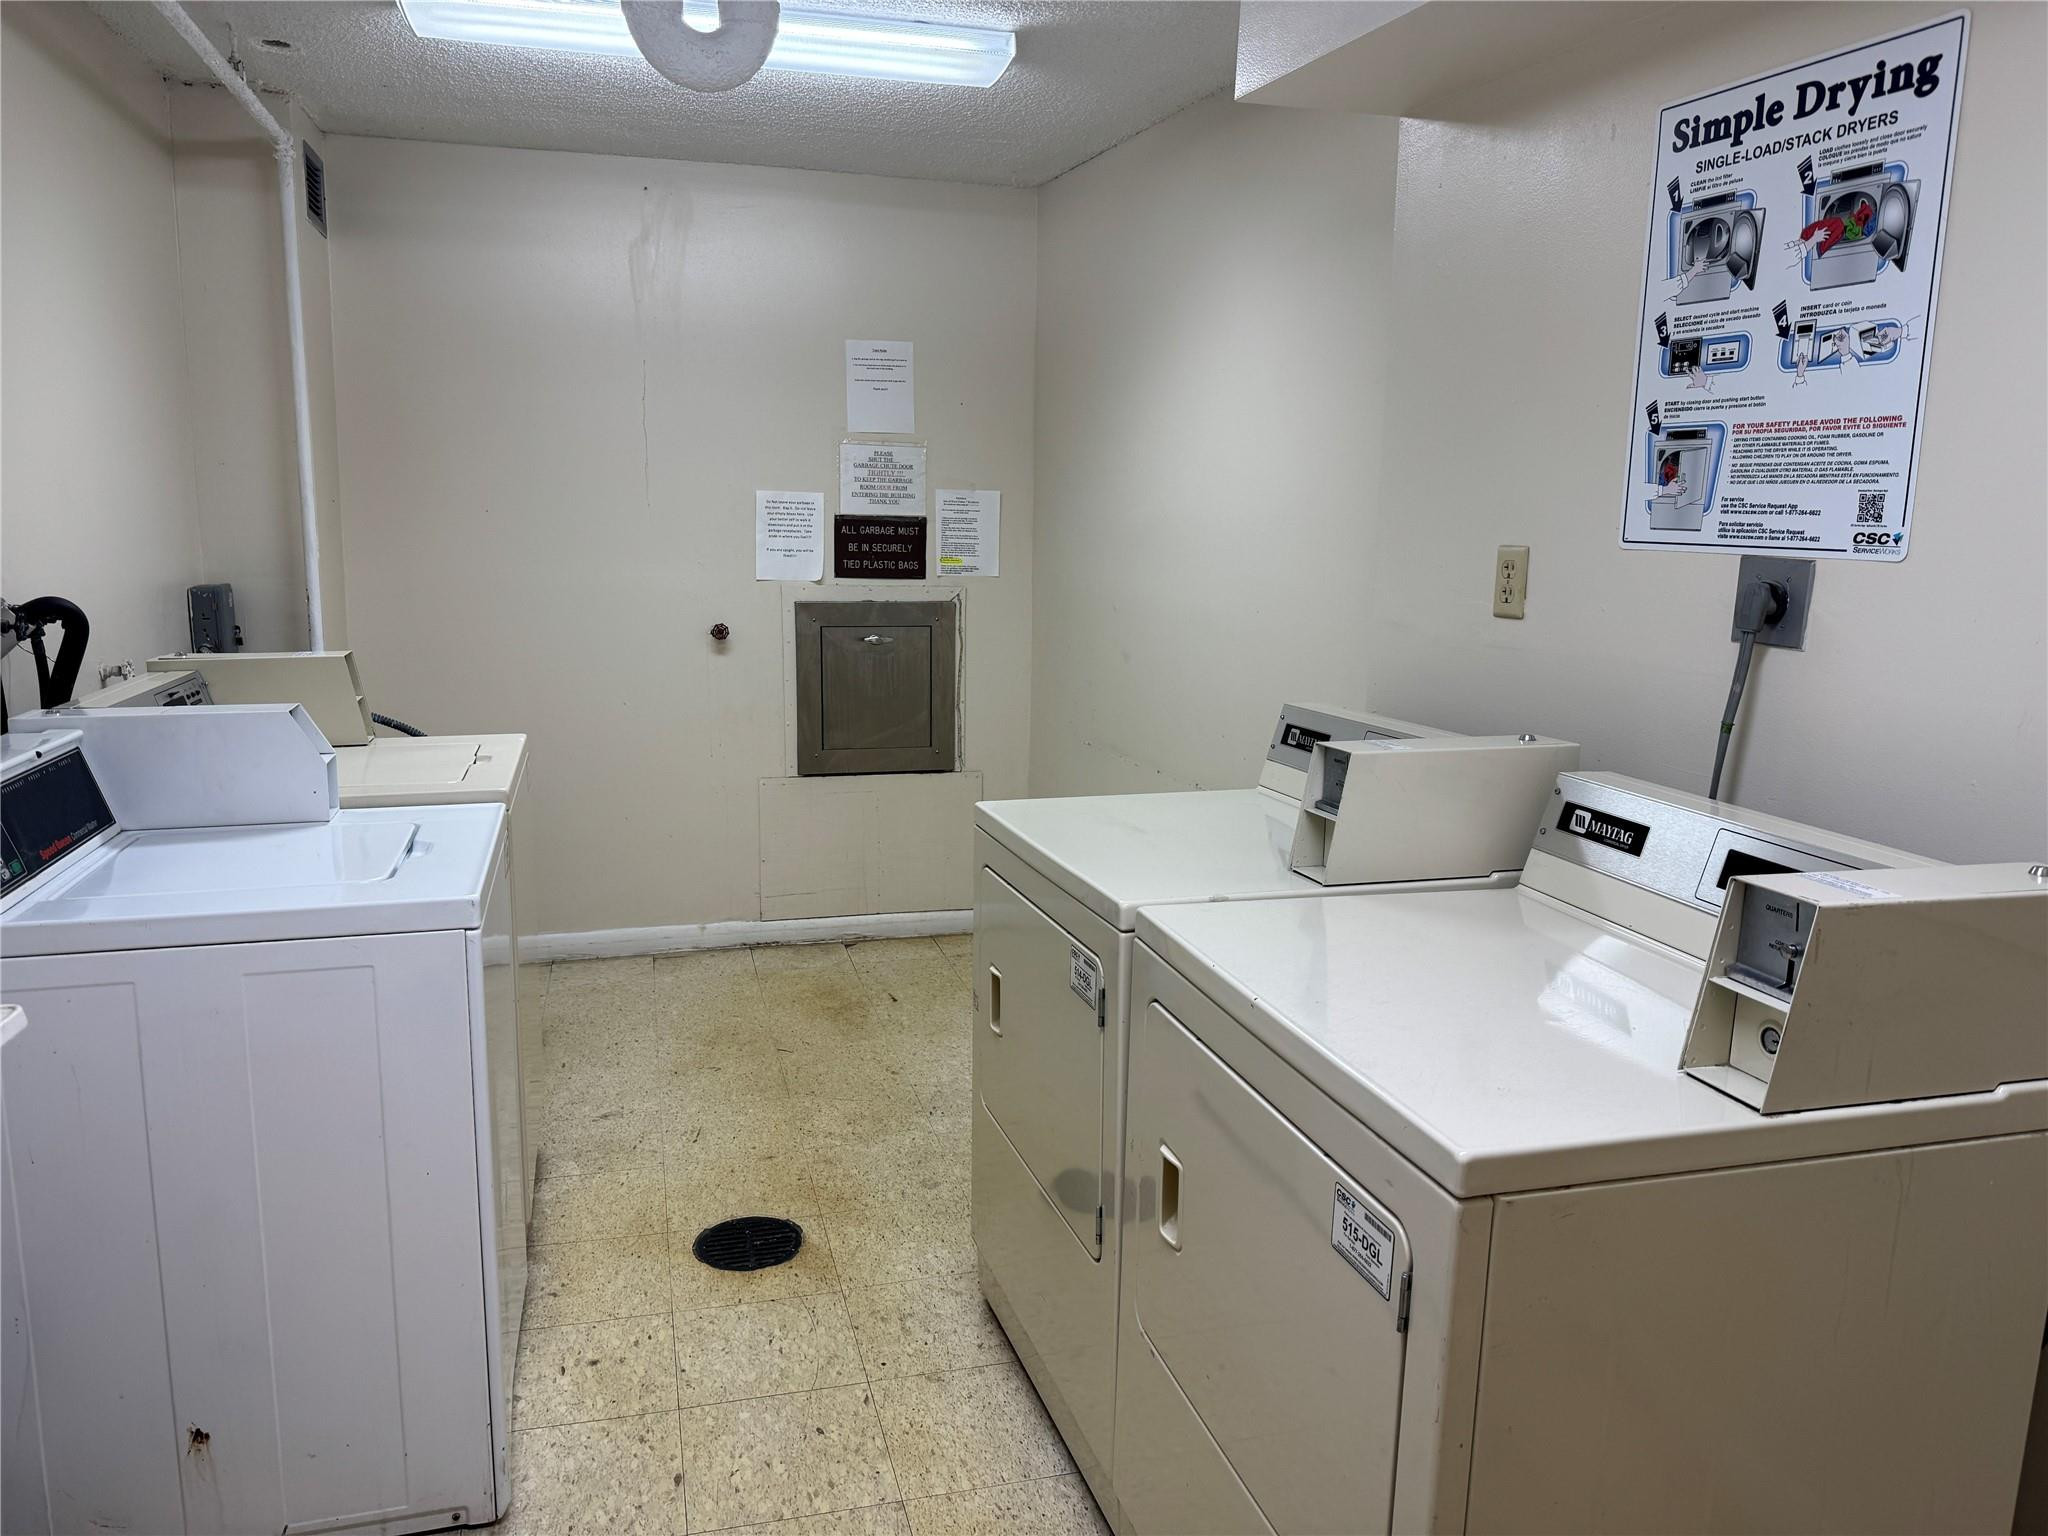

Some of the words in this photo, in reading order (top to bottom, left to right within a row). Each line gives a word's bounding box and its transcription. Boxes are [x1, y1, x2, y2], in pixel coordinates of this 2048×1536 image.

[1672, 93, 1784, 153] Simple
[1793, 54, 1943, 120] Drying
[1696, 127, 1832, 174] SINGLE-LOAD/STACK
[1836, 110, 1898, 139] DRYERS
[1819, 147, 1833, 155] LOAD
[1835, 143, 1850, 151] clothes
[1852, 139, 1868, 148] loosely
[1906, 125, 1927, 134] securely
[1691, 179, 1706, 187] CLEAN
[1804, 171, 1813, 184] 2
[1800, 309, 1836, 318] INTRODUZCA
[1778, 315, 1787, 327] 4
[1660, 326, 1666, 337] 3
[1651, 414, 1658, 424] 5
[1860, 415, 1903, 423] FOLLOWING
[841, 526, 857, 534] ALL
[860, 526, 895, 535] GARBAGE
[898, 527, 919, 535] MUST
[1853, 532, 1890, 545] CSC
[848, 543, 858, 551] BE
[872, 544, 912, 552] SECURELY
[843, 559, 860, 568] TIED
[863, 560, 896, 569] PLASTIC
[899, 561, 919, 569] BAGS
[1589, 820, 1634, 844] MAYTAG
[1766, 904, 1793, 918] QUARTERS
[1337, 1189, 1351, 1205] CSC
[1343, 1217, 1383, 1266] 515-DGL
